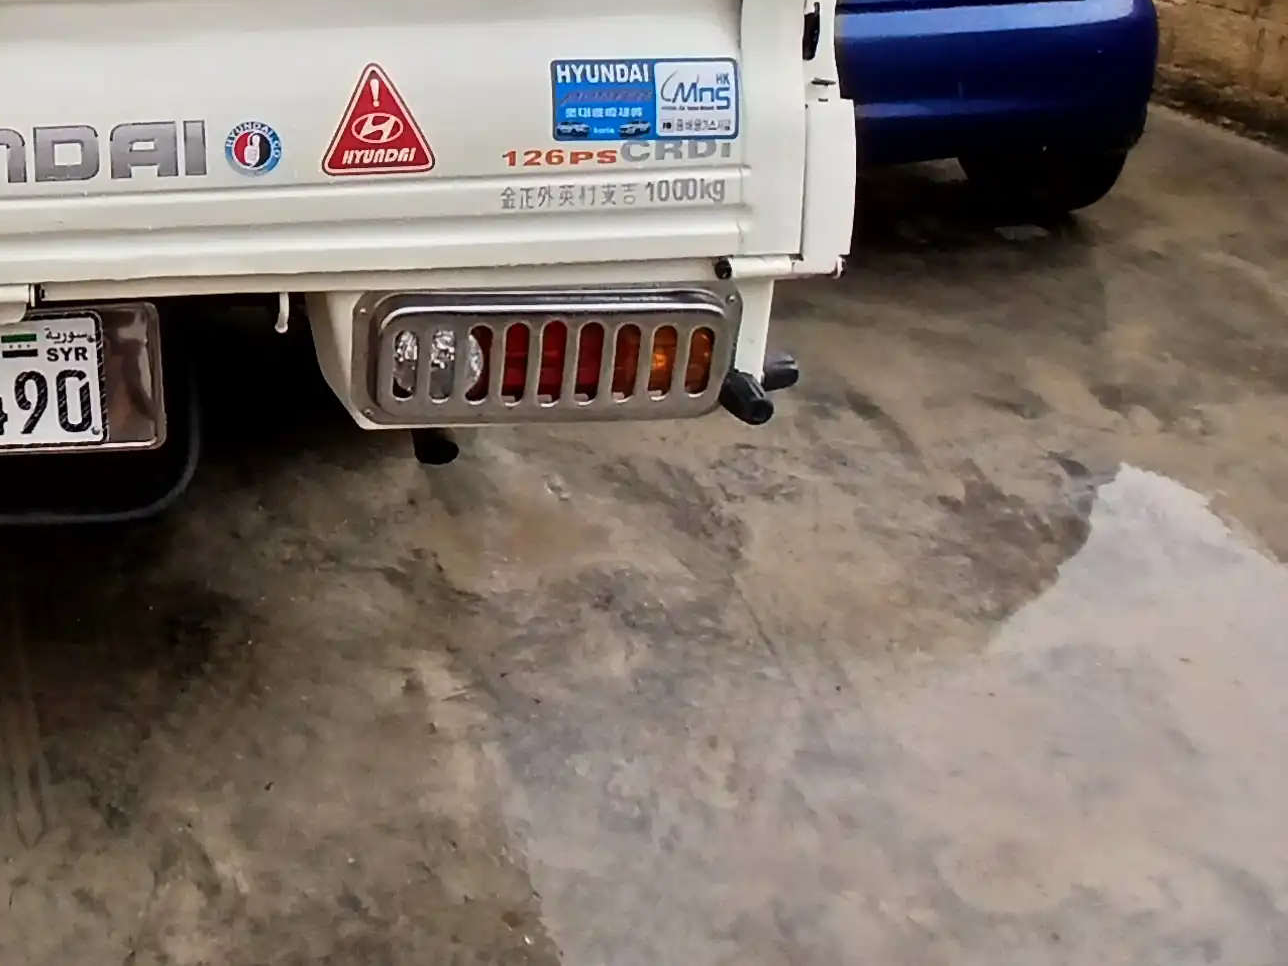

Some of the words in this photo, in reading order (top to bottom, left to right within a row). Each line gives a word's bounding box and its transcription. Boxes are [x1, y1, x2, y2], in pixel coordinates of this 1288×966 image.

[556, 63, 649, 84] HYUNDAI
[342, 148, 416, 165] HYUNDAI
[502, 149, 618, 167] 126PS
[645, 178, 725, 202] 1000kg
[46, 346, 88, 362] SYR
